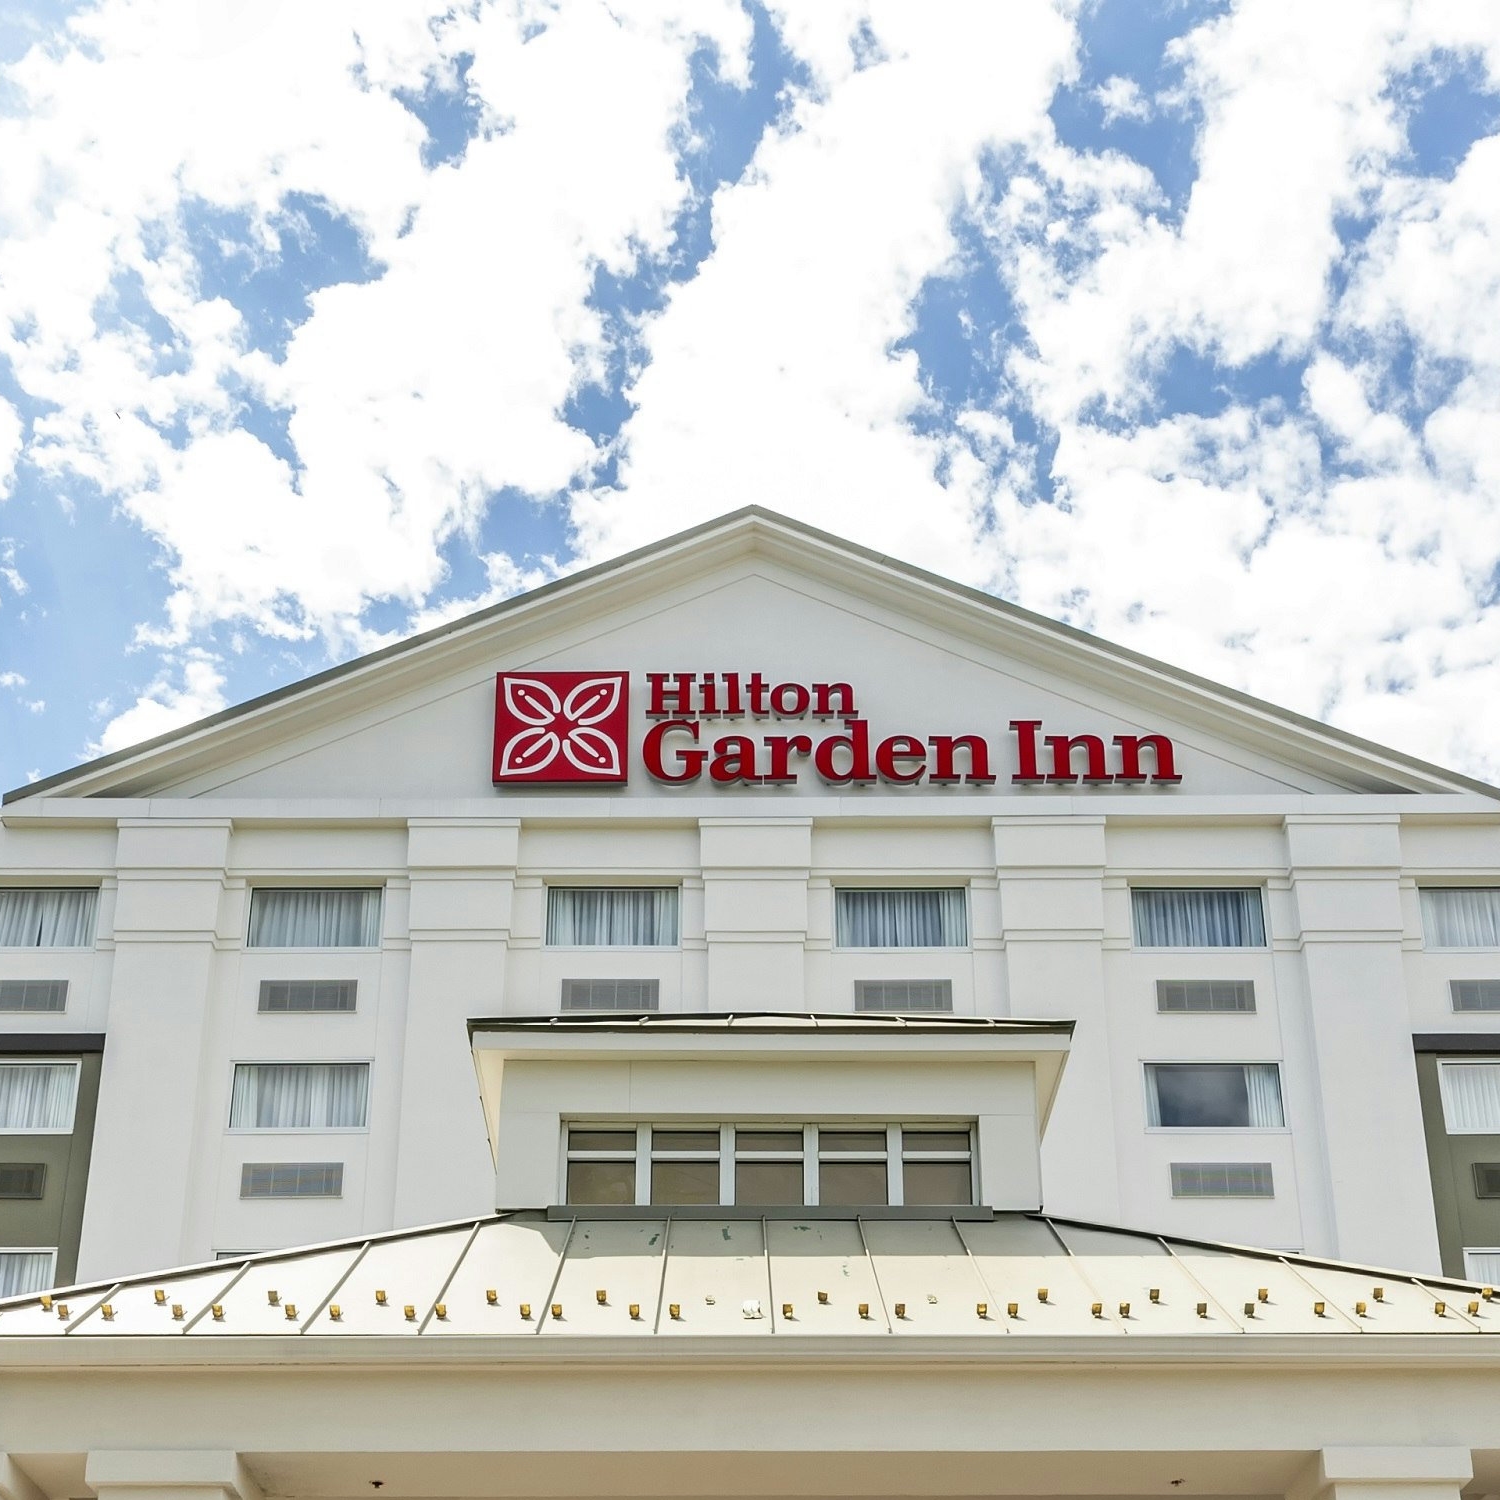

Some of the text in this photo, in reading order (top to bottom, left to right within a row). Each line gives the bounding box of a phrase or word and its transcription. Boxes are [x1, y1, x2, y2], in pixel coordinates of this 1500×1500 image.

[645, 672, 859, 721] Hilton
[642, 719, 1182, 785] Garden Inn
